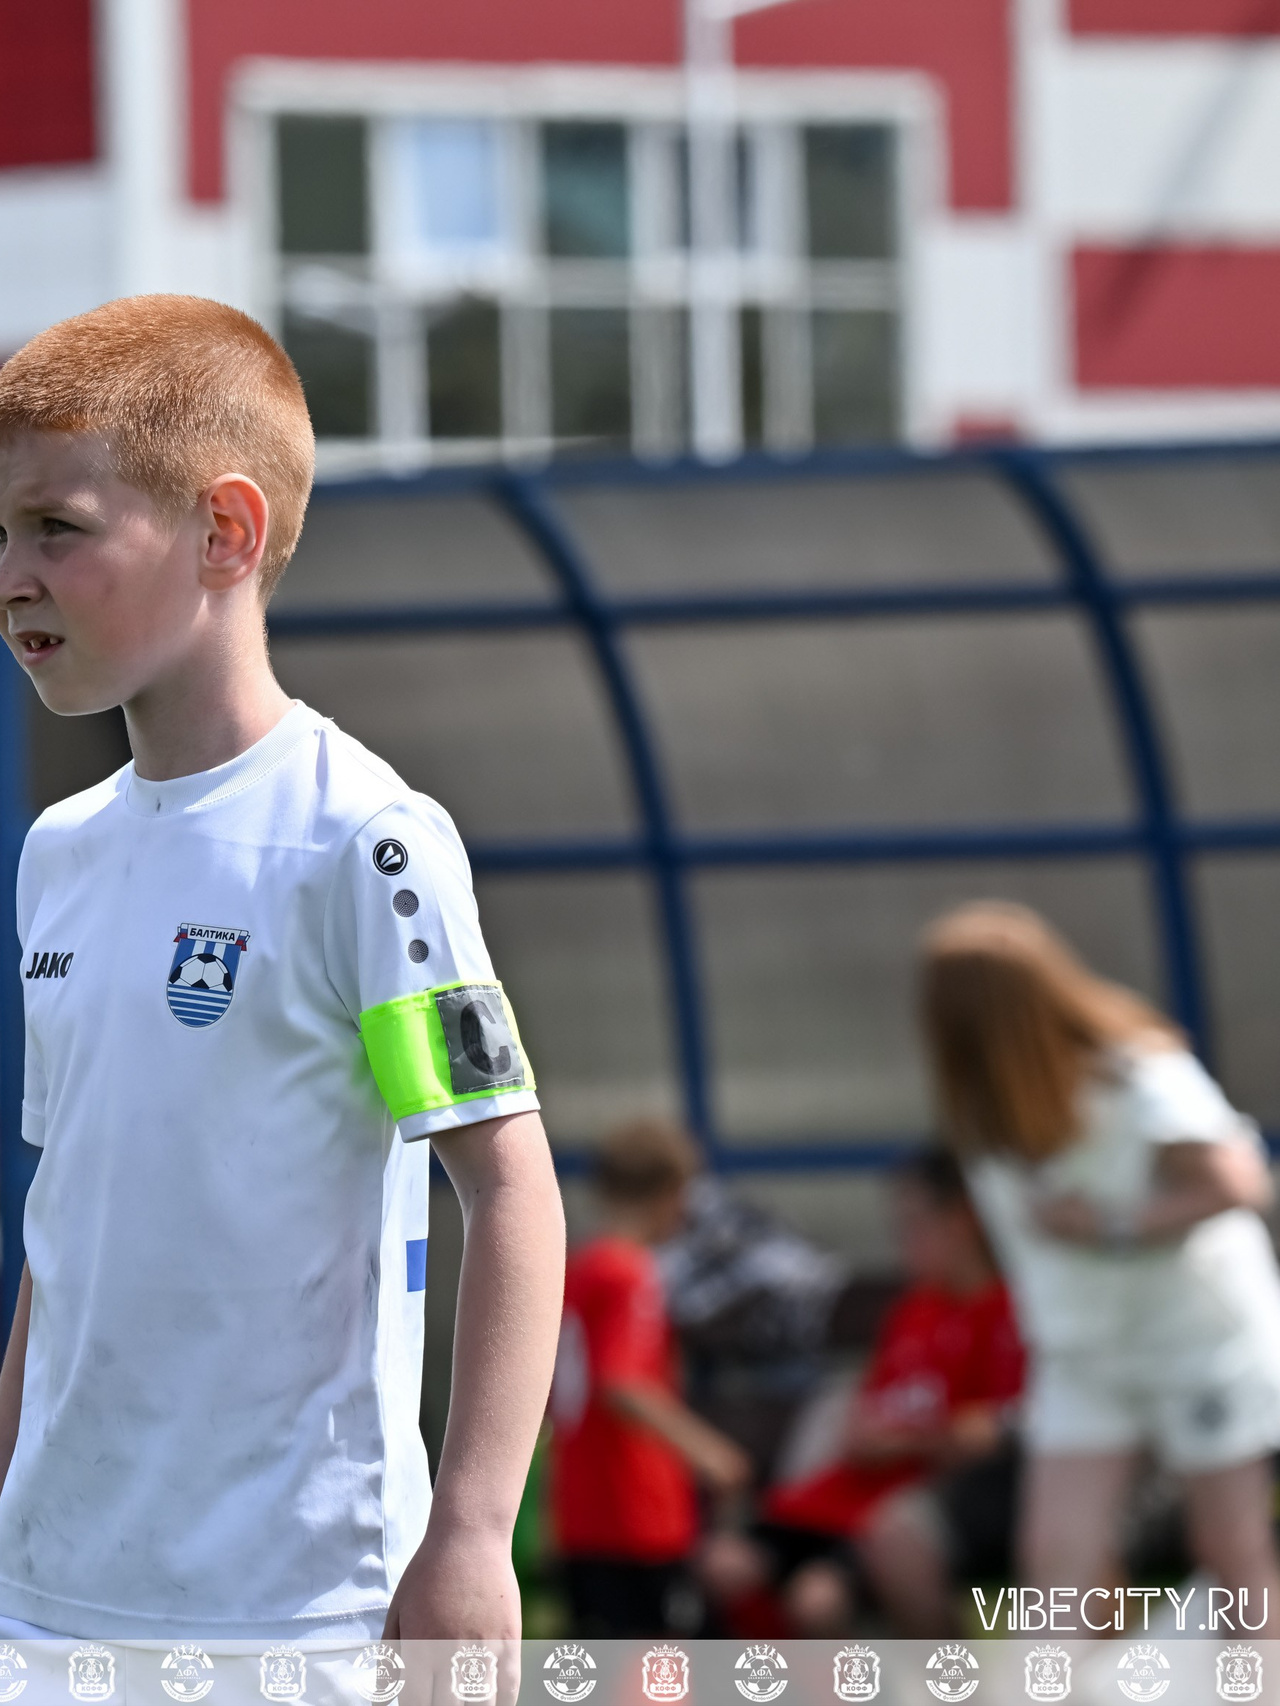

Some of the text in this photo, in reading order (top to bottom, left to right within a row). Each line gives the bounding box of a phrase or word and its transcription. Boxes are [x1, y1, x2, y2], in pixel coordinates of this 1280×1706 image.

[190, 928, 235, 941] БАЛТИКА
[26, 952, 74, 979] JAKO
[460, 1000, 511, 1076] C
